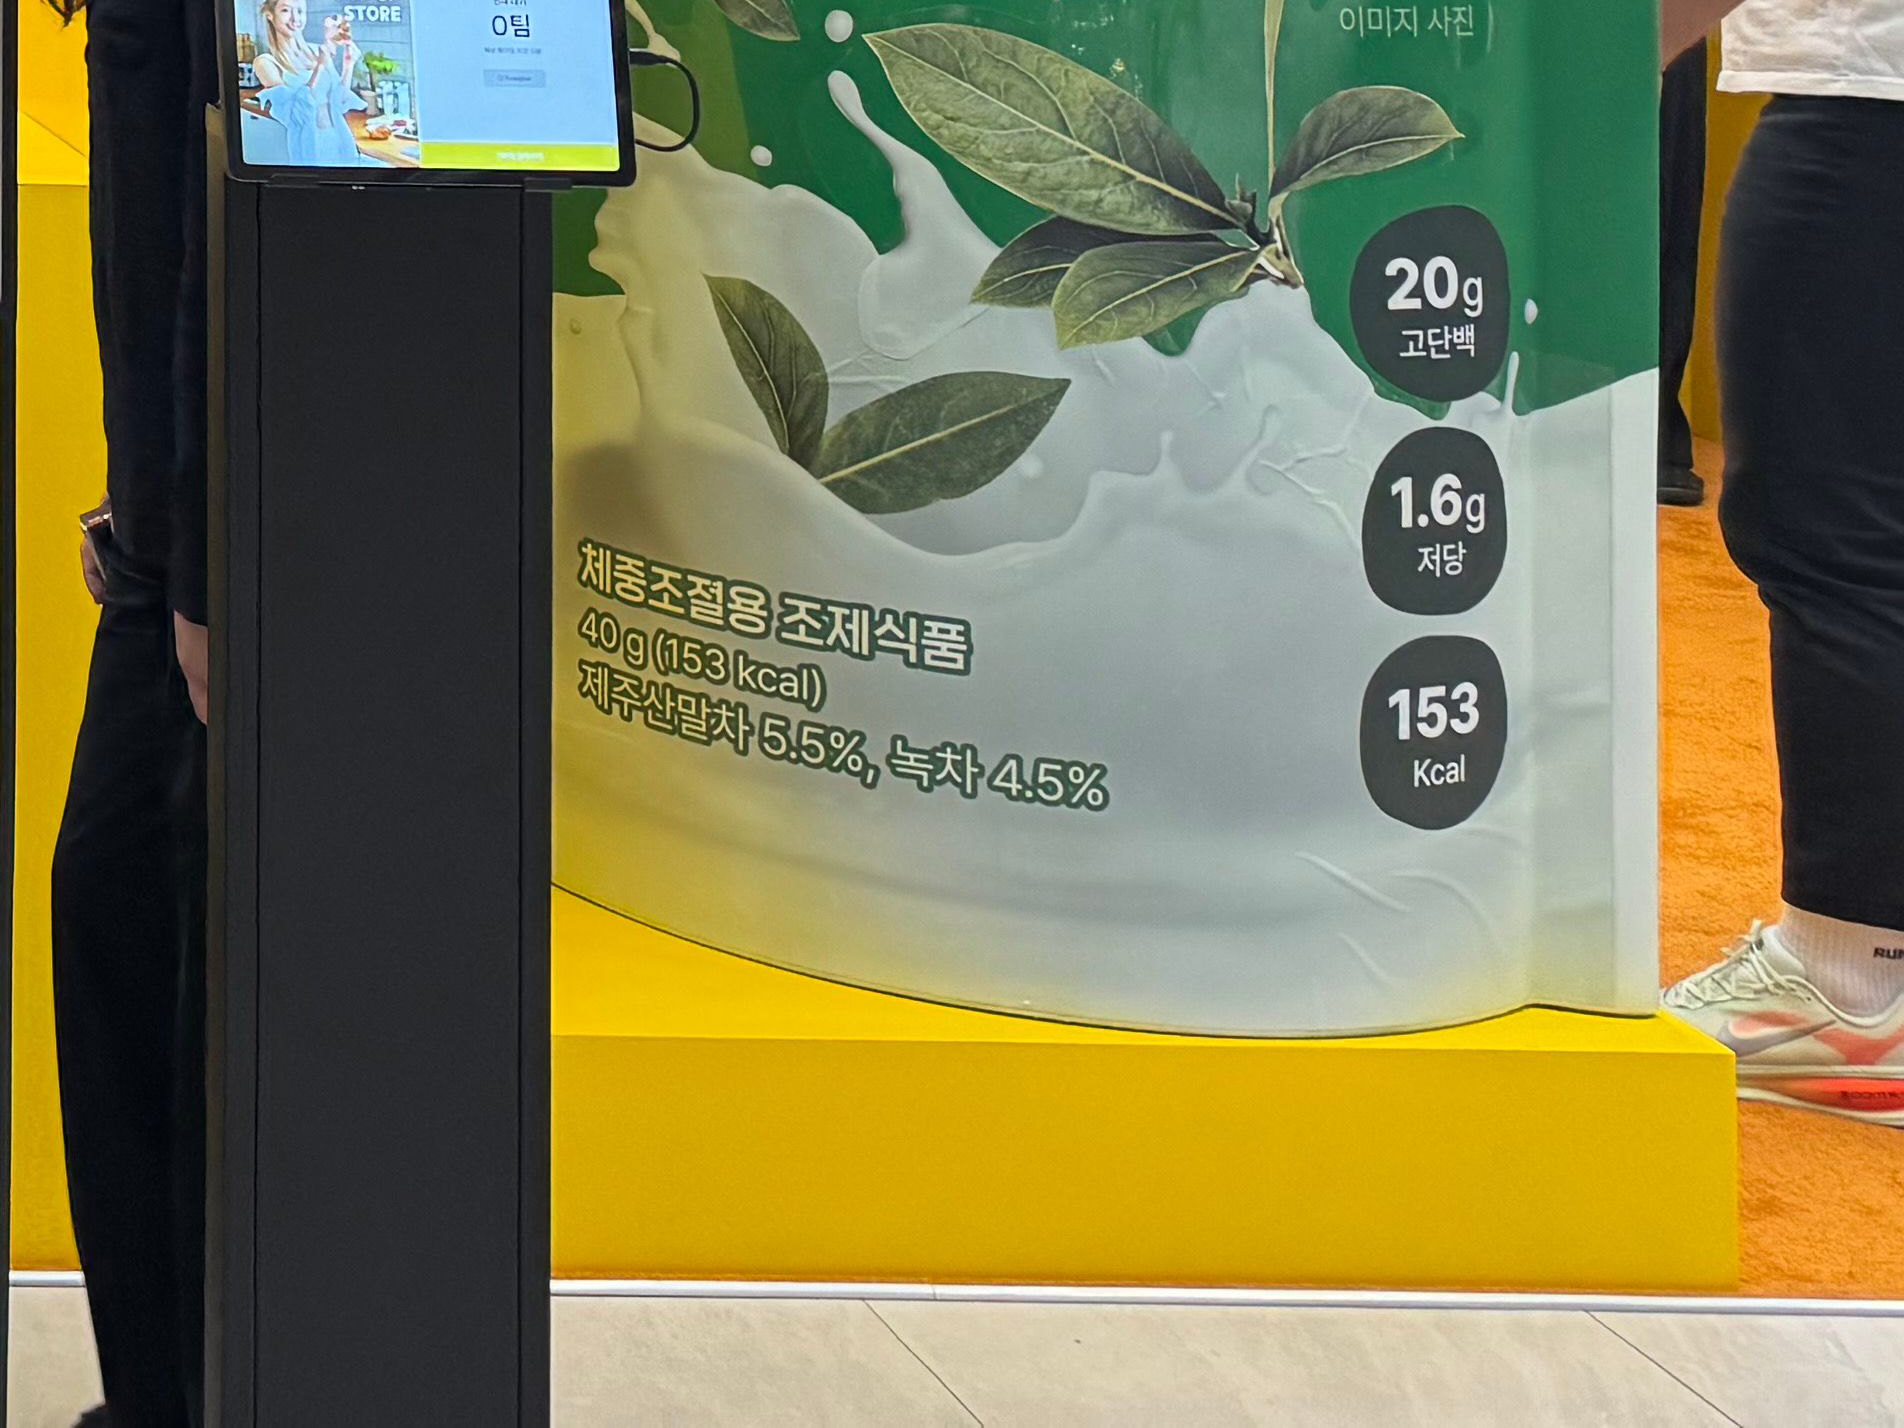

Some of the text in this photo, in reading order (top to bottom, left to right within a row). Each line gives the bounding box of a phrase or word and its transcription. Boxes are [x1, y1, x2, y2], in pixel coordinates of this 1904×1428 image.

[344, 5, 401, 22] STORE
[492, 14, 530, 37] 0팀
[1339, 4, 1475, 37] 이미지 사진
[1385, 255, 1484, 316] 20g
[1398, 325, 1476, 359] 고단백
[1390, 474, 1486, 531] 1.6g
[1416, 541, 1466, 577] 저당
[580, 541, 969, 671] 체중조절용 조제식품
[581, 612, 825, 708] 40 g (153 kcal)
[1388, 682, 1480, 741] 153
[580, 664, 1105, 808] 제주산말차 5.5%, 녹차 4.5%
[1412, 754, 1465, 789] Kcal
